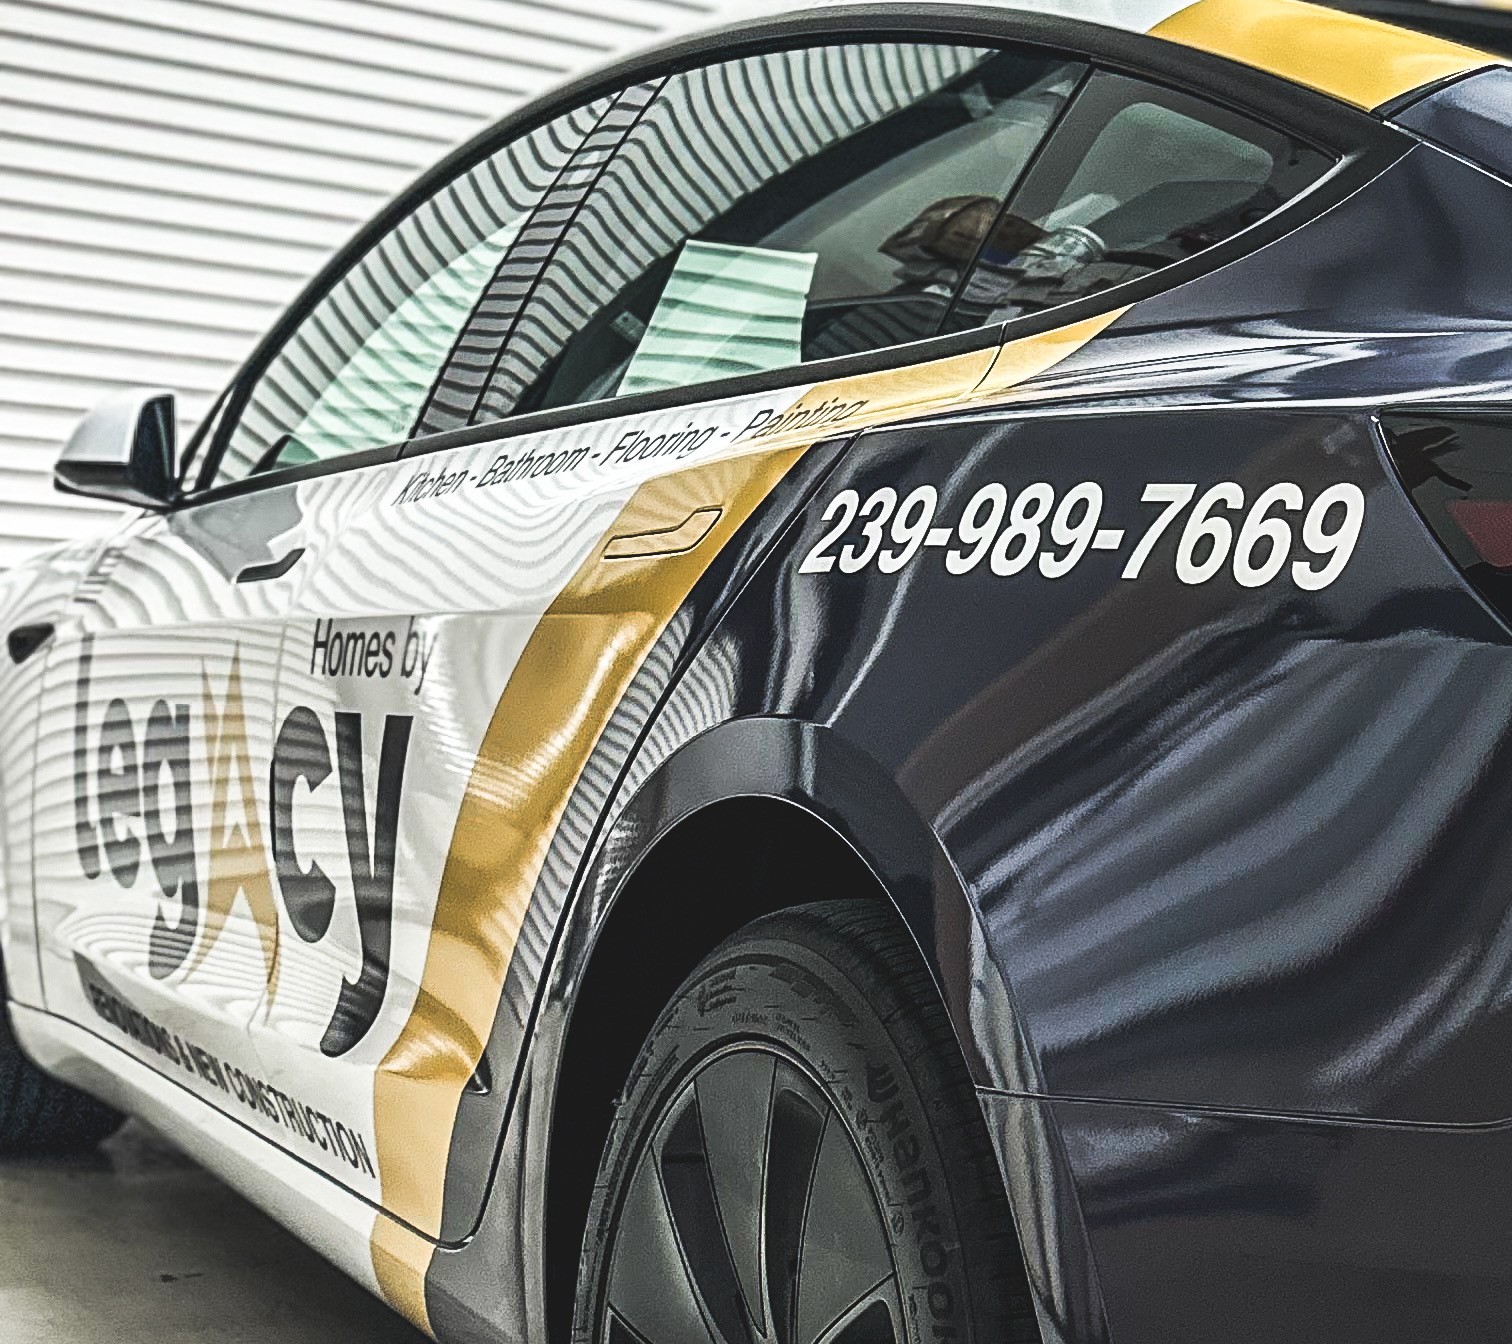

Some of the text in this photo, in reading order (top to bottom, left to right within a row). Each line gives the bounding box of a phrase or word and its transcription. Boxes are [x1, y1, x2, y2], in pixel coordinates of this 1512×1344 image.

[392, 467, 467, 506] Kitchen
[475, 445, 584, 489] Bathroom
[604, 421, 718, 466] Flooring
[732, 397, 870, 443] Painting
[798, 481, 1366, 591] 239-989-7669
[310, 616, 438, 696] Homes by
[224, 1062, 376, 1178] CONSTRUCTION
